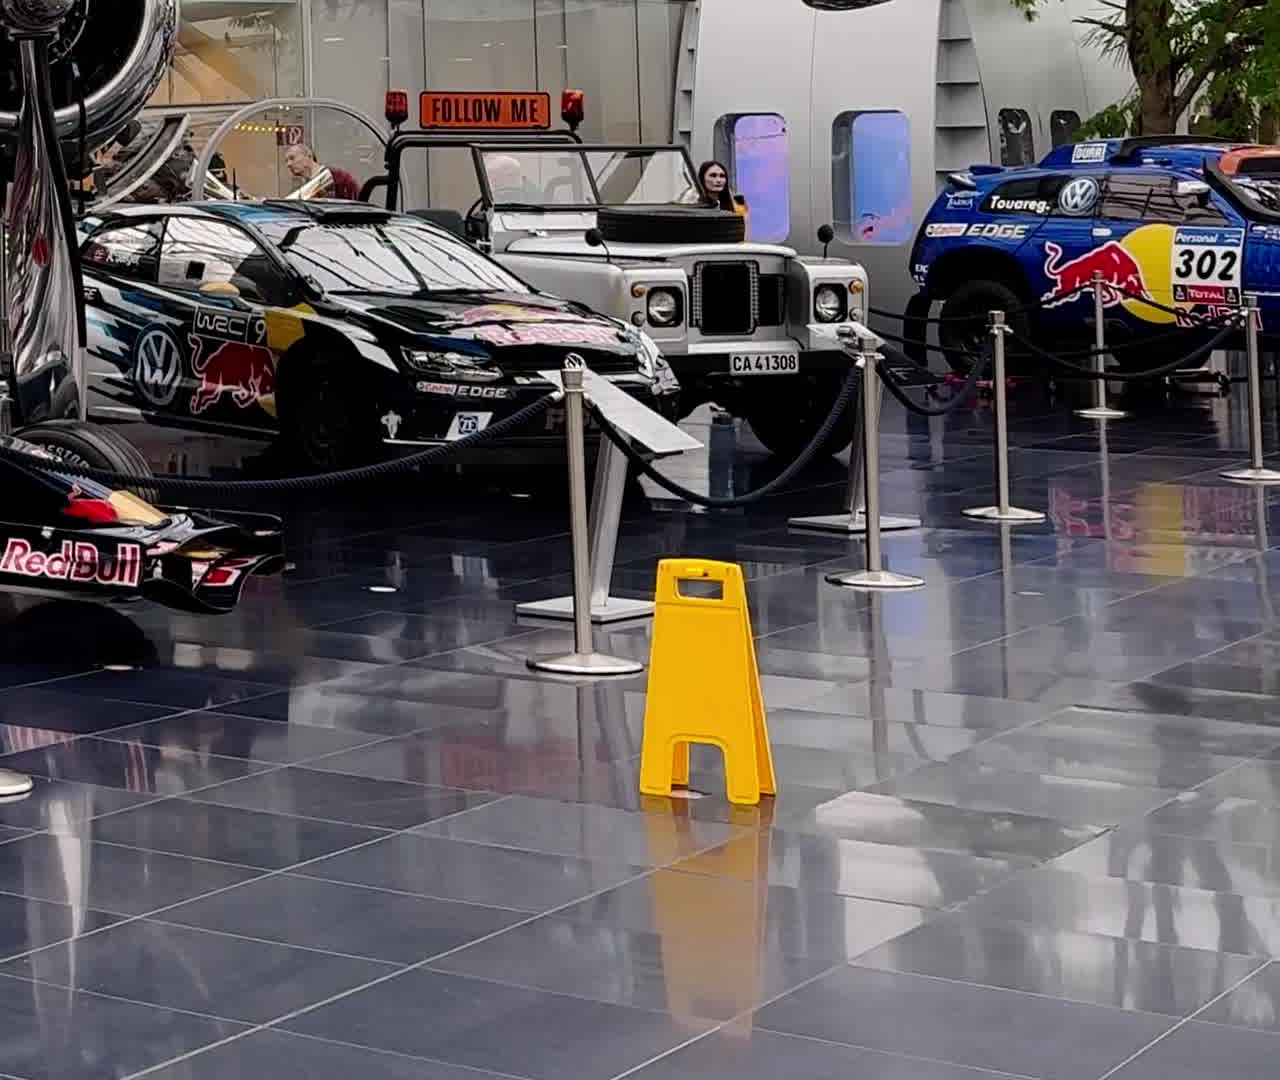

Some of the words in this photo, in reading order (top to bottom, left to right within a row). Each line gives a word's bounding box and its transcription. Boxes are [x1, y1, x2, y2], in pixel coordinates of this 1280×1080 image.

[431, 98, 501, 123] FOLLOW
[510, 98, 538, 123] ME
[966, 224, 1029, 238] EDGE
[1175, 249, 1238, 281] 302
[1188, 289, 1225, 300] TOTAL
[197, 311, 244, 336] WRC
[732, 356, 752, 371] CA
[755, 354, 796, 370] 41308
[457, 385, 508, 398] EDGE
